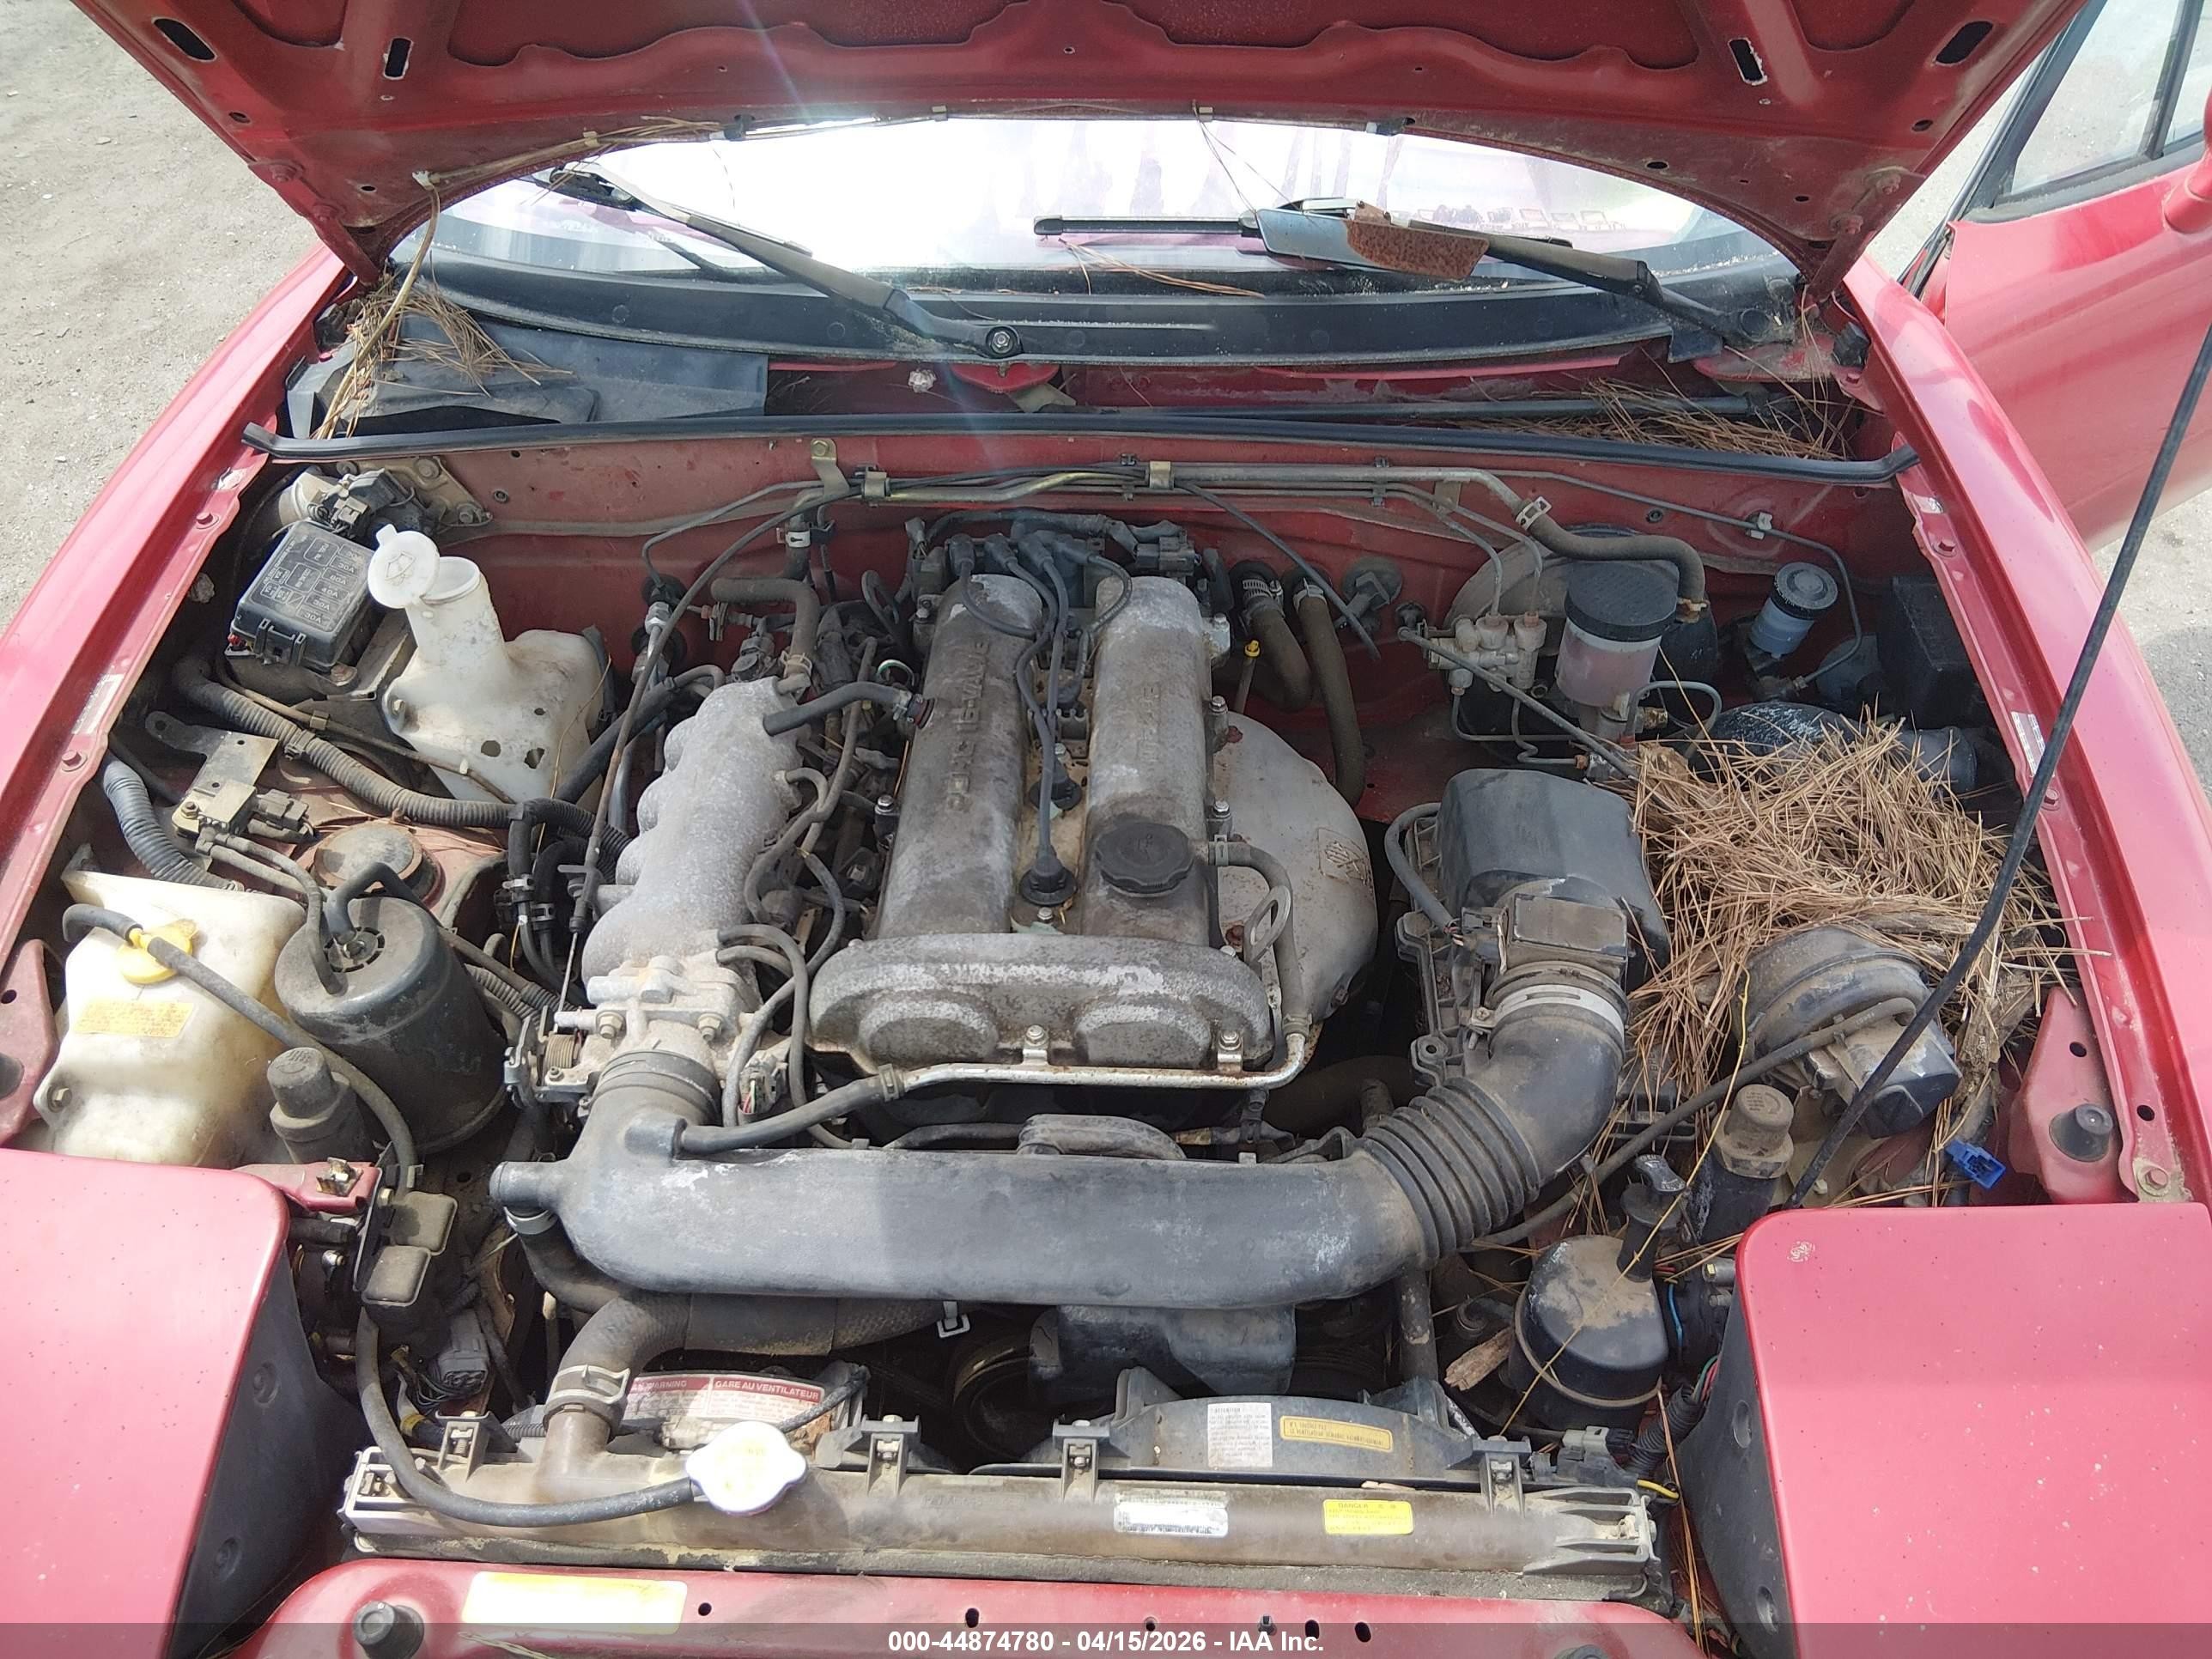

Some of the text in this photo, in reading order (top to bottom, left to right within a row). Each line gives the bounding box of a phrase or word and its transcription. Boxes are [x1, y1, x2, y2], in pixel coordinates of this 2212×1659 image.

[647, 1380, 687, 1389] WARNING
[715, 1380, 818, 1400] GARE AU VENTILATEUR
